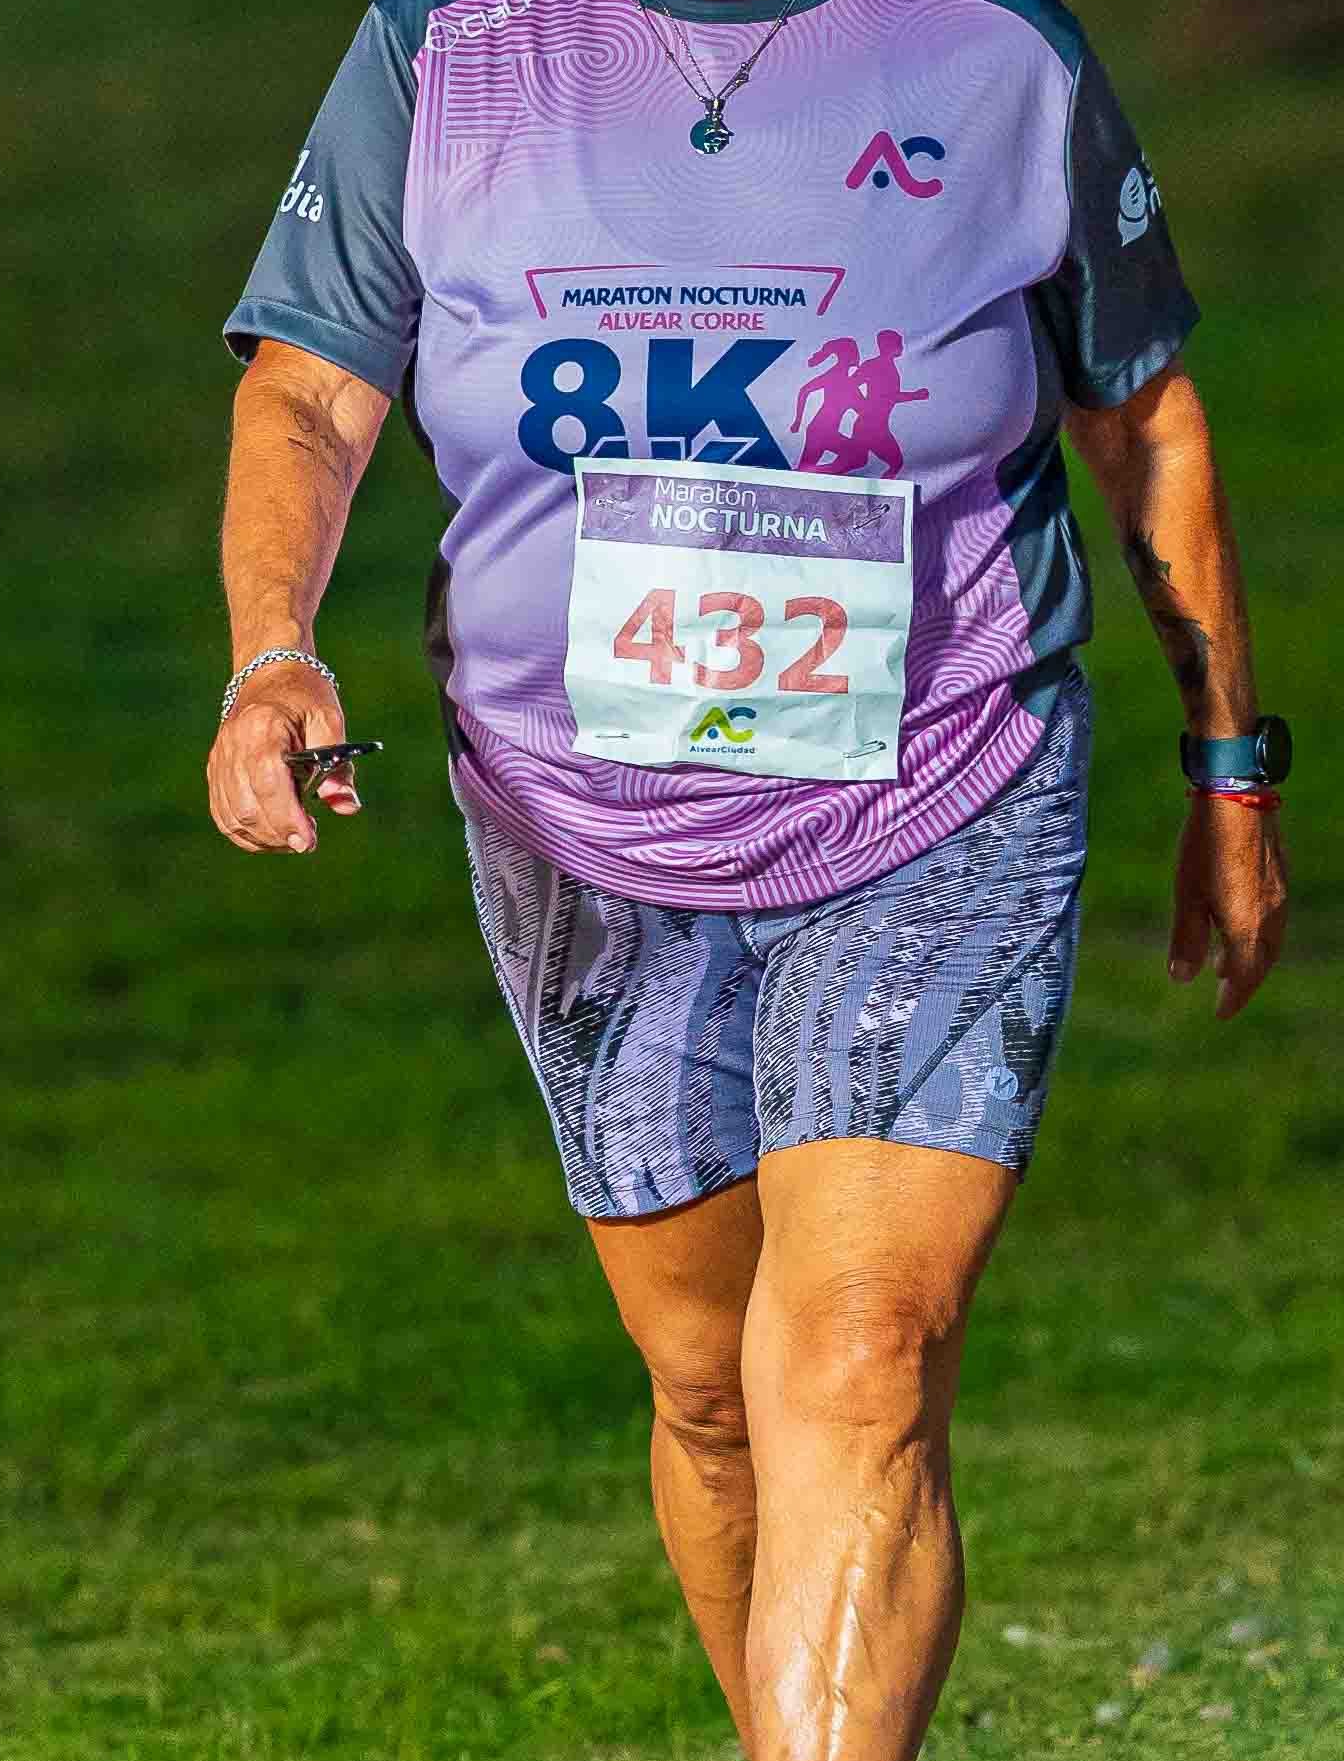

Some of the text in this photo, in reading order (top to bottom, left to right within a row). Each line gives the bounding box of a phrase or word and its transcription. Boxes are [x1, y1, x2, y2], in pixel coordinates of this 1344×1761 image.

[561, 286, 808, 307] MARATON NOCTURNA
[597, 311, 766, 332] ALVEAR CORRE
[517, 337, 795, 475] 8K
[655, 478, 756, 507] Maratón
[652, 506, 829, 541] NOCTURNA
[613, 588, 850, 695] 432
